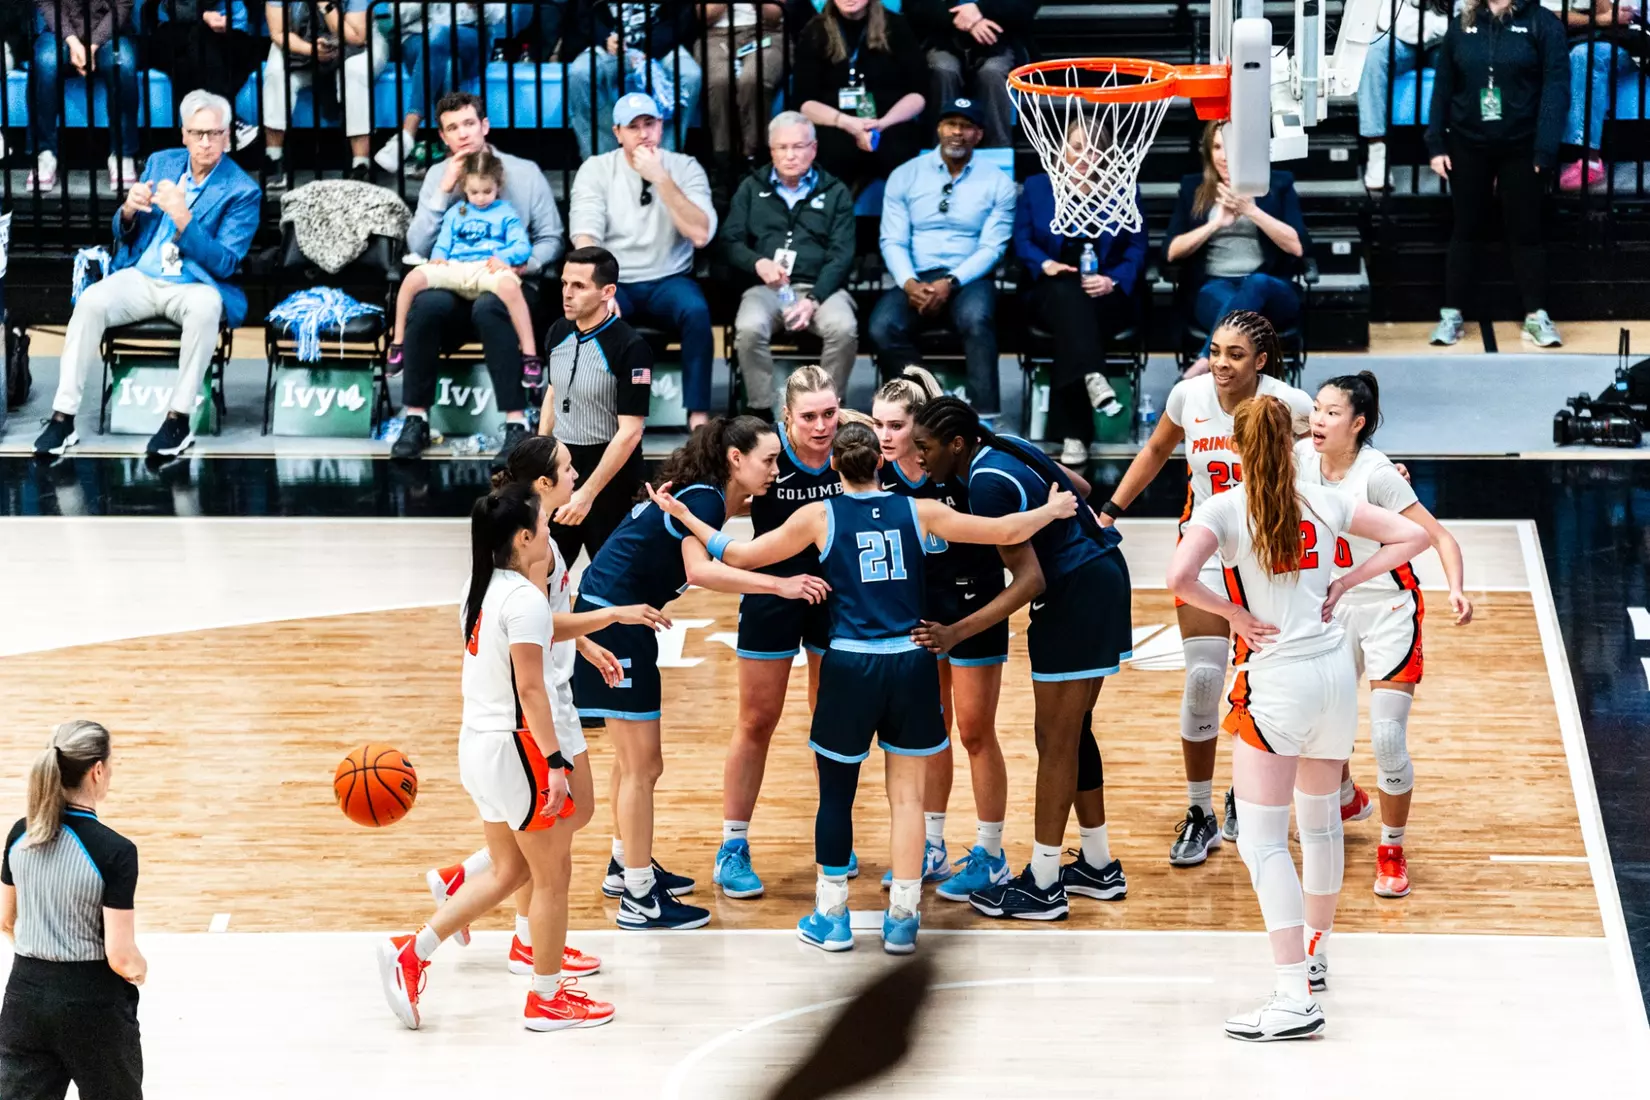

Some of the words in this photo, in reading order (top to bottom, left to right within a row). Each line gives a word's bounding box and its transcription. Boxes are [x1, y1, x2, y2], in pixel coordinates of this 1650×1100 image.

[119, 379, 173, 415] Ivy
[281, 380, 337, 416] Ivy
[437, 378, 492, 415] Ivy
[872, 508, 880, 519] C
[855, 529, 908, 583] 21
